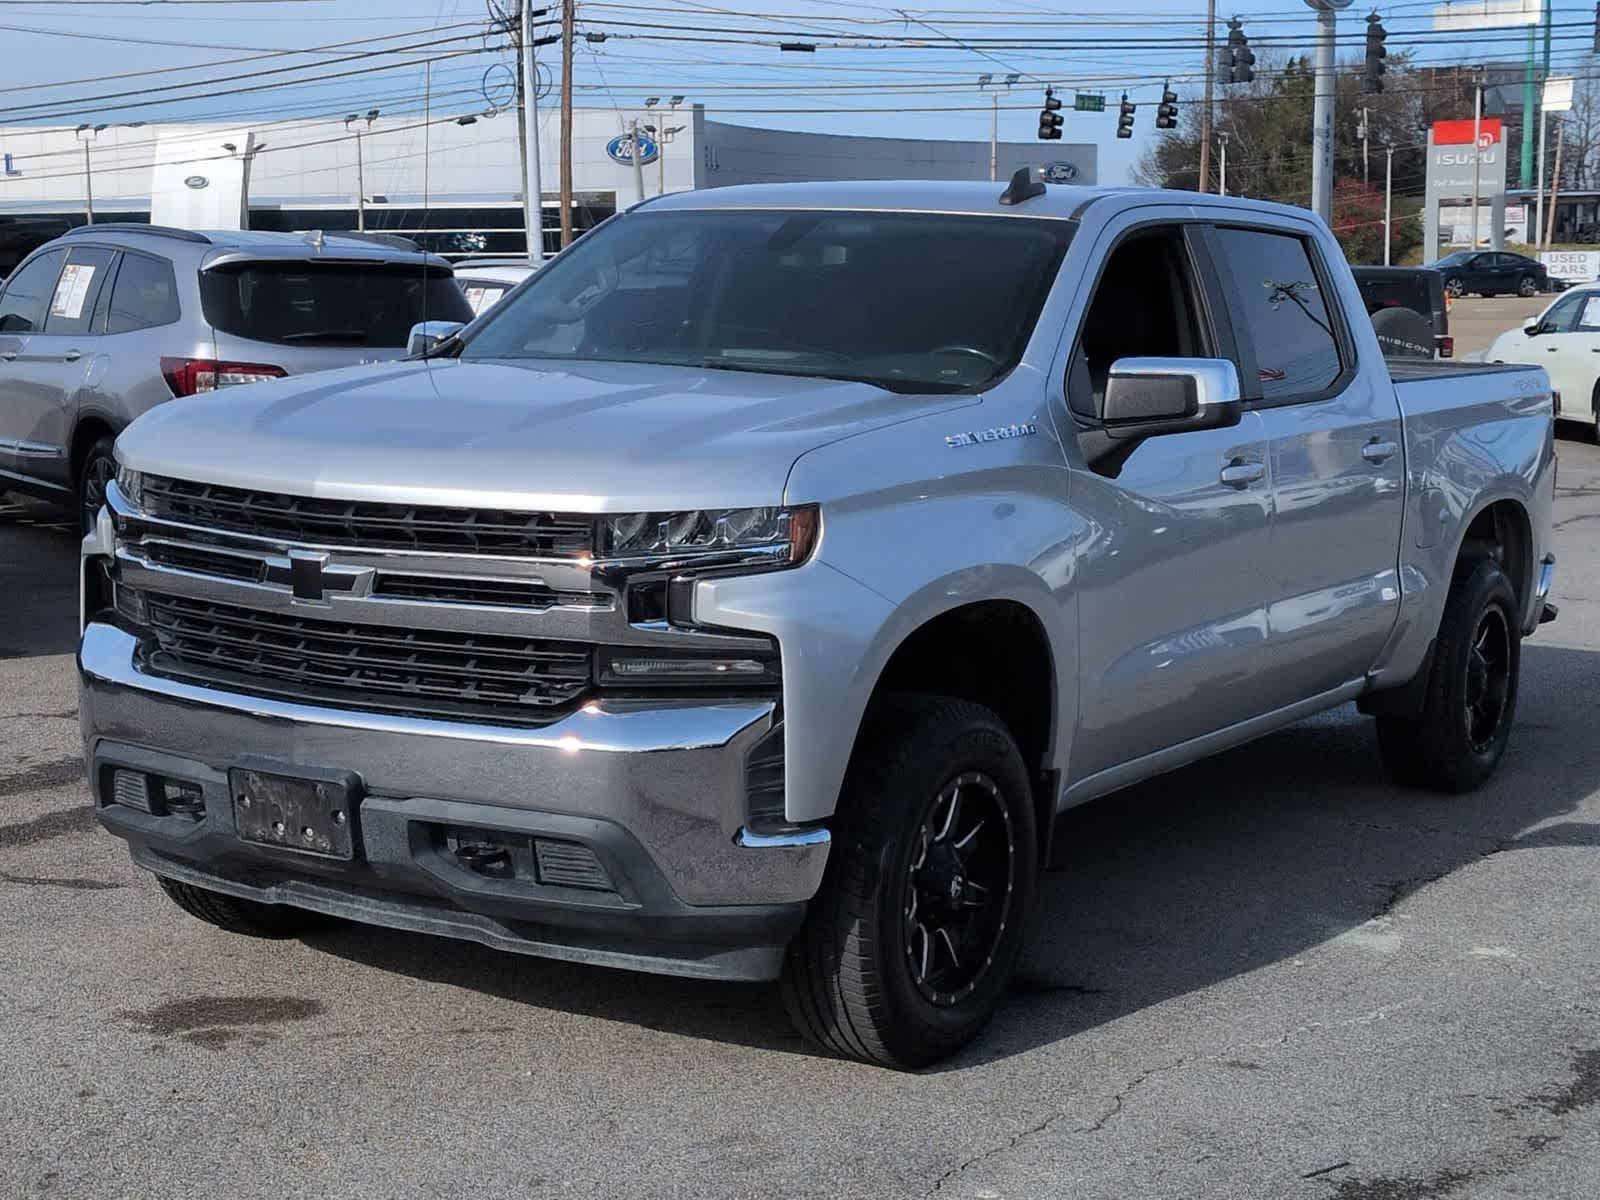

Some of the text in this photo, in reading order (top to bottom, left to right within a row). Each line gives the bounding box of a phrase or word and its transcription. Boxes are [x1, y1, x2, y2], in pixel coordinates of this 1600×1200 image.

[1549, 253, 1588, 264] USED
[1549, 264, 1588, 275] CARS
[1378, 335, 1430, 354] RUBICON
